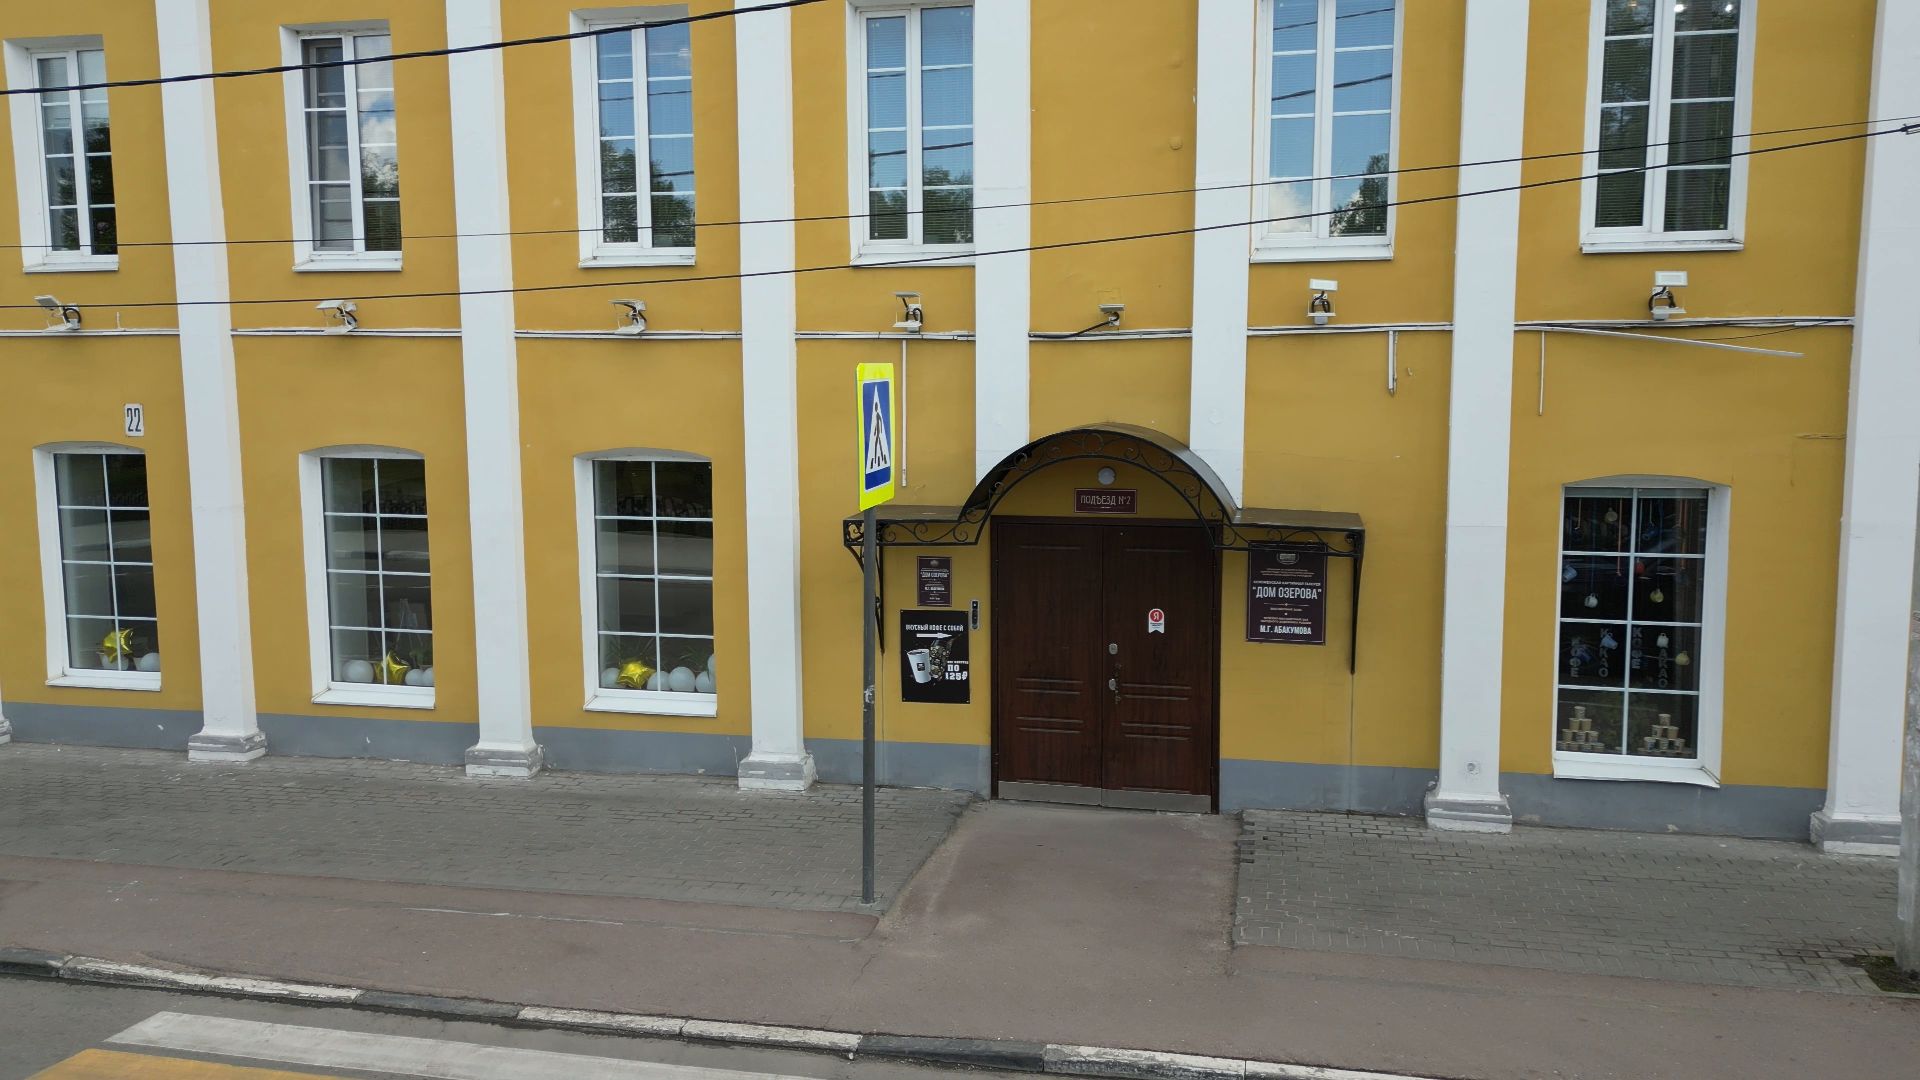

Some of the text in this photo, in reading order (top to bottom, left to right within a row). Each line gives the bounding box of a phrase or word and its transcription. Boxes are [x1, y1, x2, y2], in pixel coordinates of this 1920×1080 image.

[127, 407, 142, 432] 22
[1080, 495, 1116, 506] ПОДЪЕЗД
[1252, 586, 1322, 600] "ДОМ ОЗЕРОВА"
[1153, 611, 1160, 620] Я
[1259, 624, 1312, 635] М.Г. АБАКУМОВА
[1598, 628, 1609, 678] ККАО
[947, 664, 960, 672] ПО
[1657, 647, 1669, 688] АКАО
